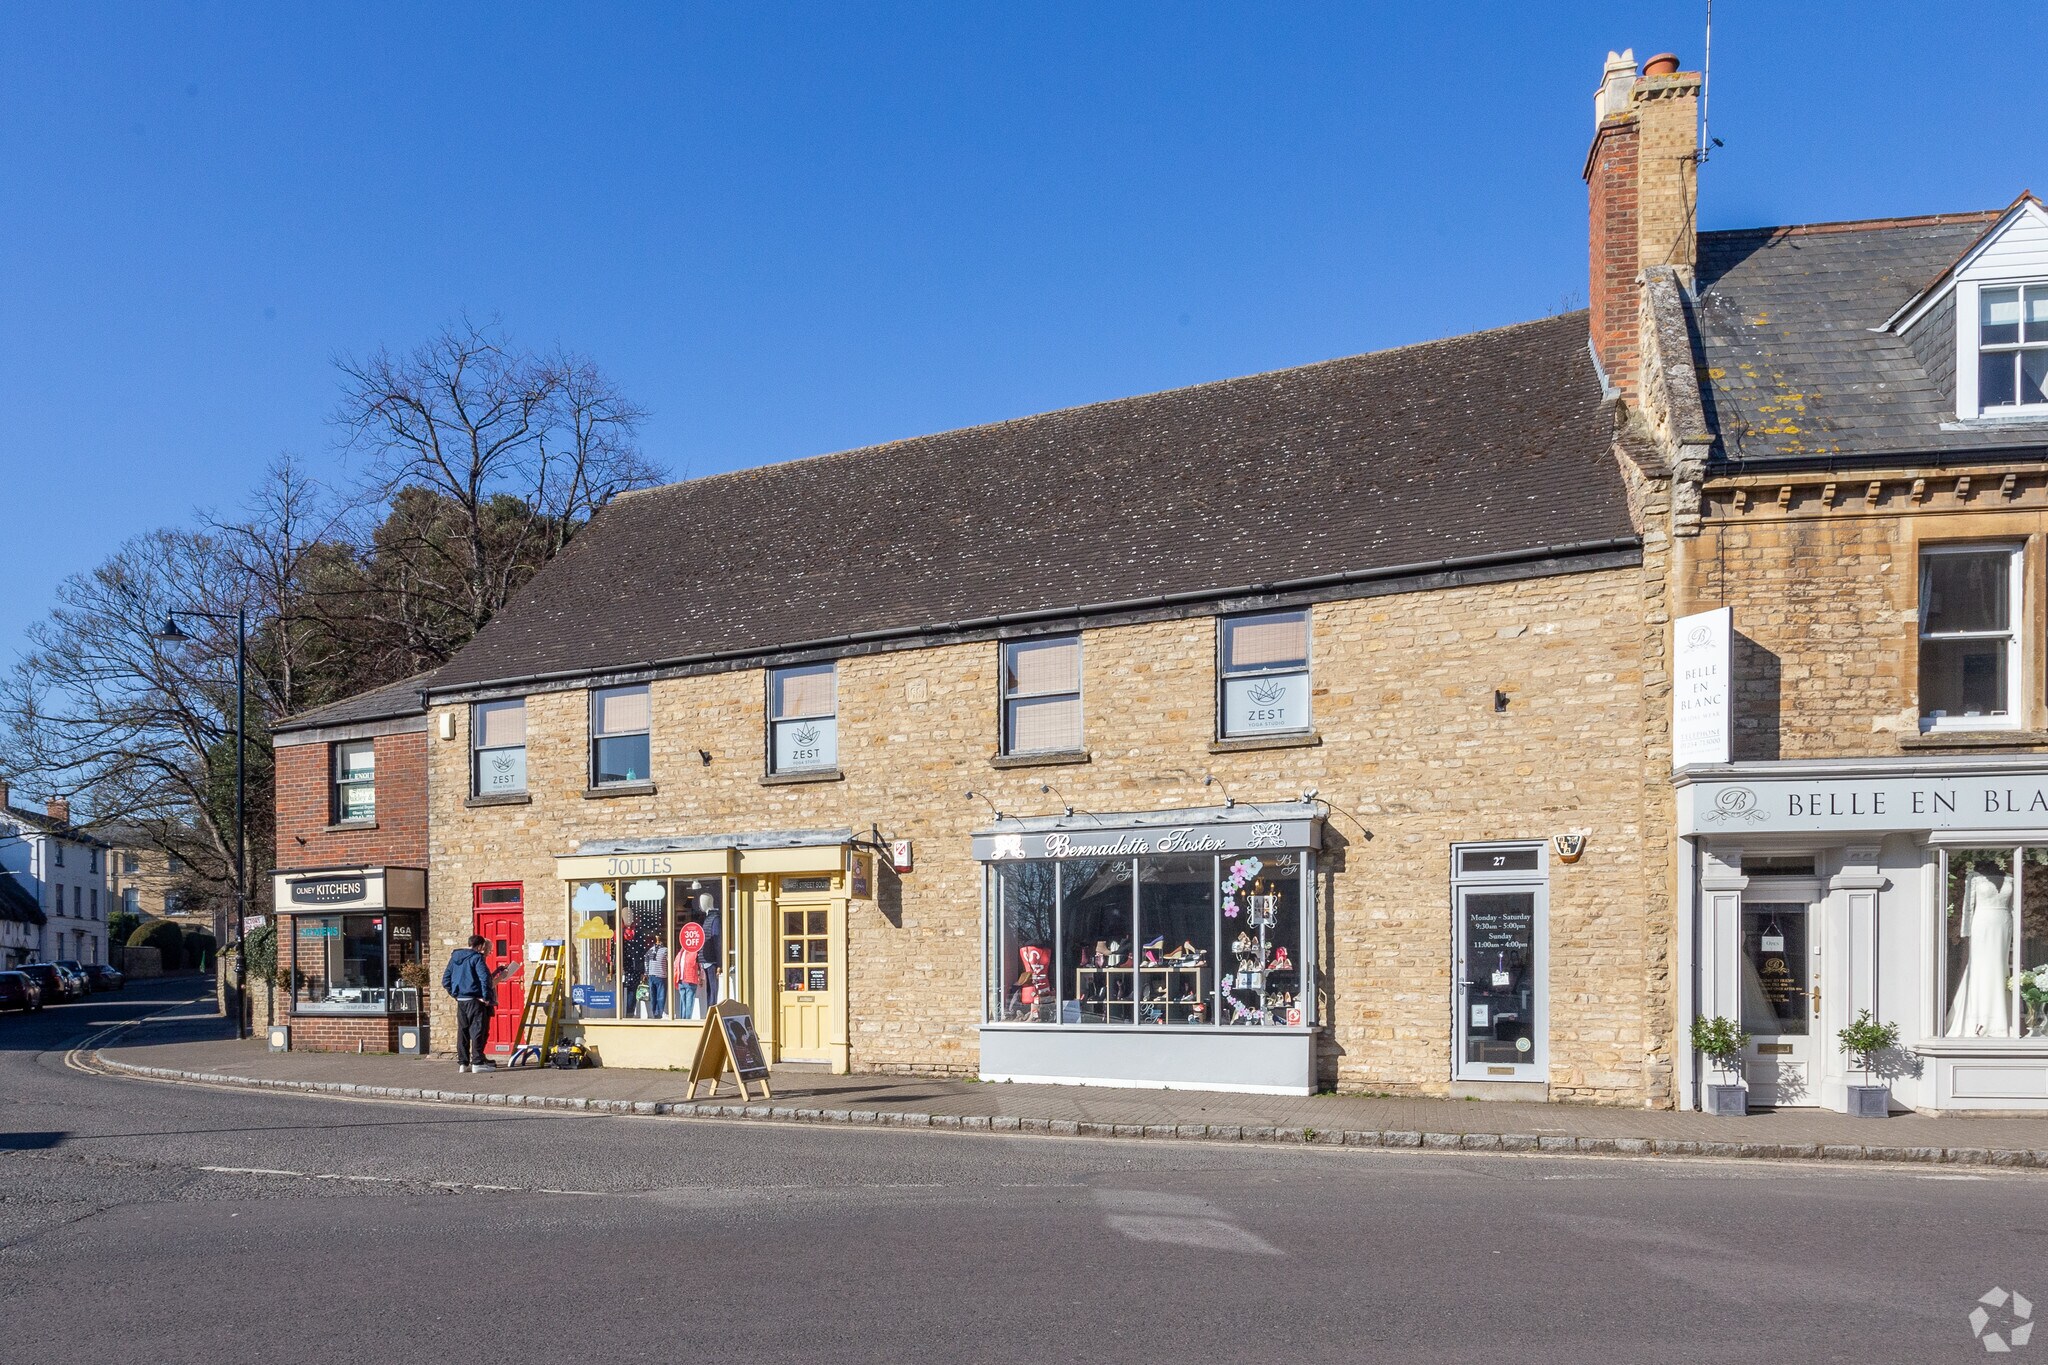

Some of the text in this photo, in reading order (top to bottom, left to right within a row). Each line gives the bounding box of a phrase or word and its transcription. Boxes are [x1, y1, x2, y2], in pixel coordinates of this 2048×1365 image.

[1685, 664, 1717, 680] BELLE
[1693, 682, 1708, 693] EN
[1681, 694, 1721, 710] BLANC
[1248, 708, 1285, 721] ZEST
[1680, 728, 1720, 739] TELEPHONE
[792, 748, 820, 760] ZEST
[492, 774, 515, 784] ZEST
[1788, 792, 1886, 816] BELLE
[1911, 790, 1956, 814] EN
[1044, 828, 1226, 858] Bernadette Foster
[608, 857, 673, 876] JOULES
[1493, 856, 1505, 866] 27
[296, 882, 360, 896] OLNEY KITCHENS
[799, 881, 815, 889] STREET
[1470, 914, 1497, 922] Monday
[1502, 913, 1531, 922] Saturday
[300, 926, 338, 937] SIEMENS
[393, 926, 412, 934] AGA
[1503, 922, 1526, 930] 5:00pm
[684, 930, 700, 938] 30%
[1488, 932, 1512, 941] Sunday
[685, 938, 700, 946] OFF
[1504, 941, 1528, 950] 4:00pm
